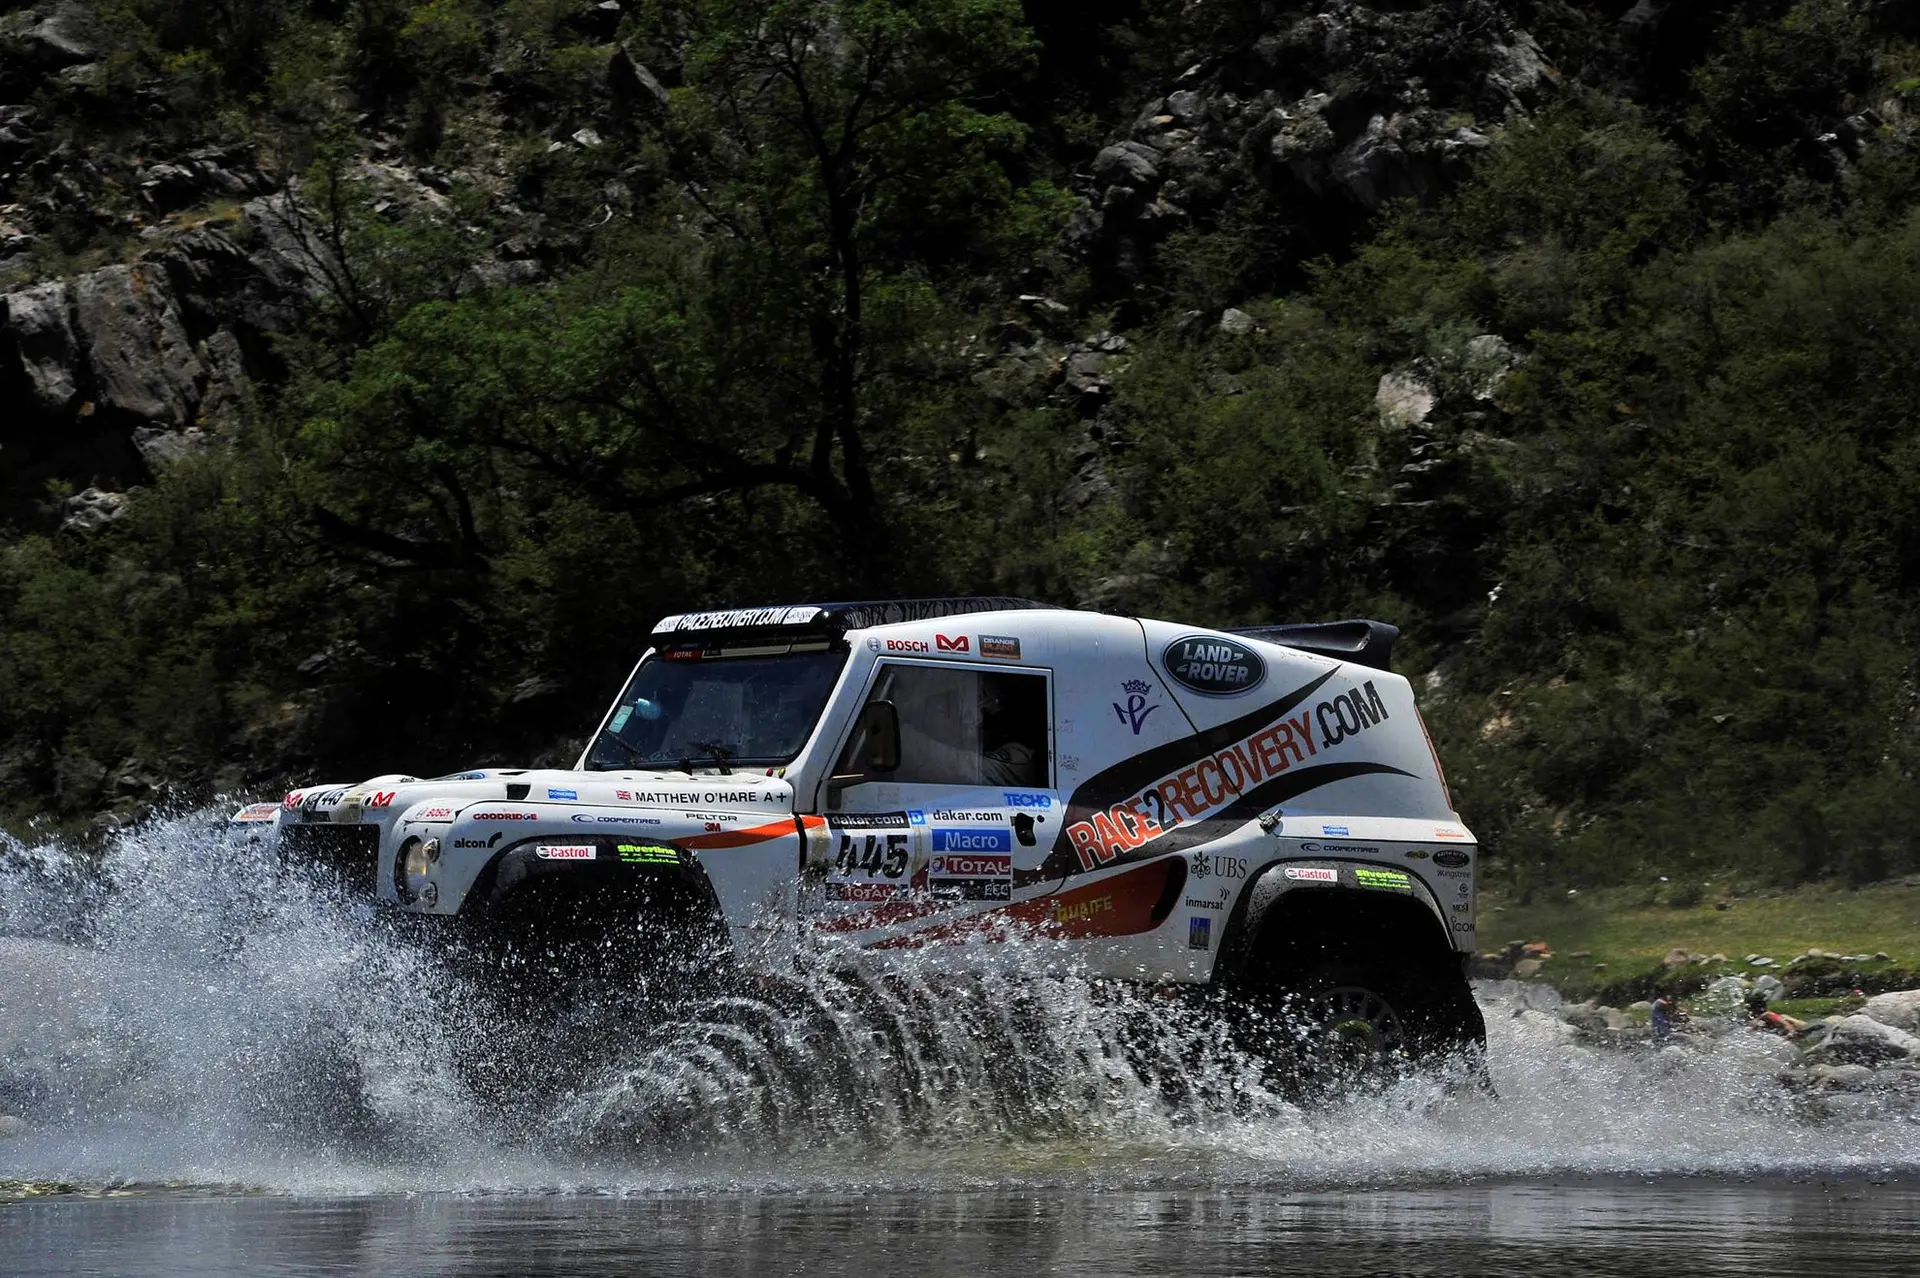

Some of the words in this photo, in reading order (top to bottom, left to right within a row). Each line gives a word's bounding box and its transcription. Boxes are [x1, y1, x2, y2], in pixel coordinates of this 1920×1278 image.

[887, 640, 929, 653] BOSCH
[1182, 643, 1233, 661] LAND
[1187, 664, 1249, 683] ROVER
[1066, 680, 1390, 871] RACE2RECOVERY.COM
[635, 792, 700, 804] MATTHEW
[704, 791, 757, 803] O'HARE
[1003, 794, 1052, 809] TECHO
[472, 812, 538, 821] GOODRIDGE
[685, 813, 738, 822] PELTOR
[831, 814, 905, 826] dakar.com
[932, 809, 1003, 821] dakar.com
[704, 822, 722, 832] 3M
[454, 837, 487, 849] alcon
[945, 831, 999, 849] Macro
[550, 847, 590, 858] Castrol
[836, 834, 909, 879] 445
[949, 857, 1010, 873] TOTAL
[1214, 855, 1248, 879] UBS
[1297, 869, 1332, 880] Castrol
[1186, 896, 1224, 911] inmarsat
